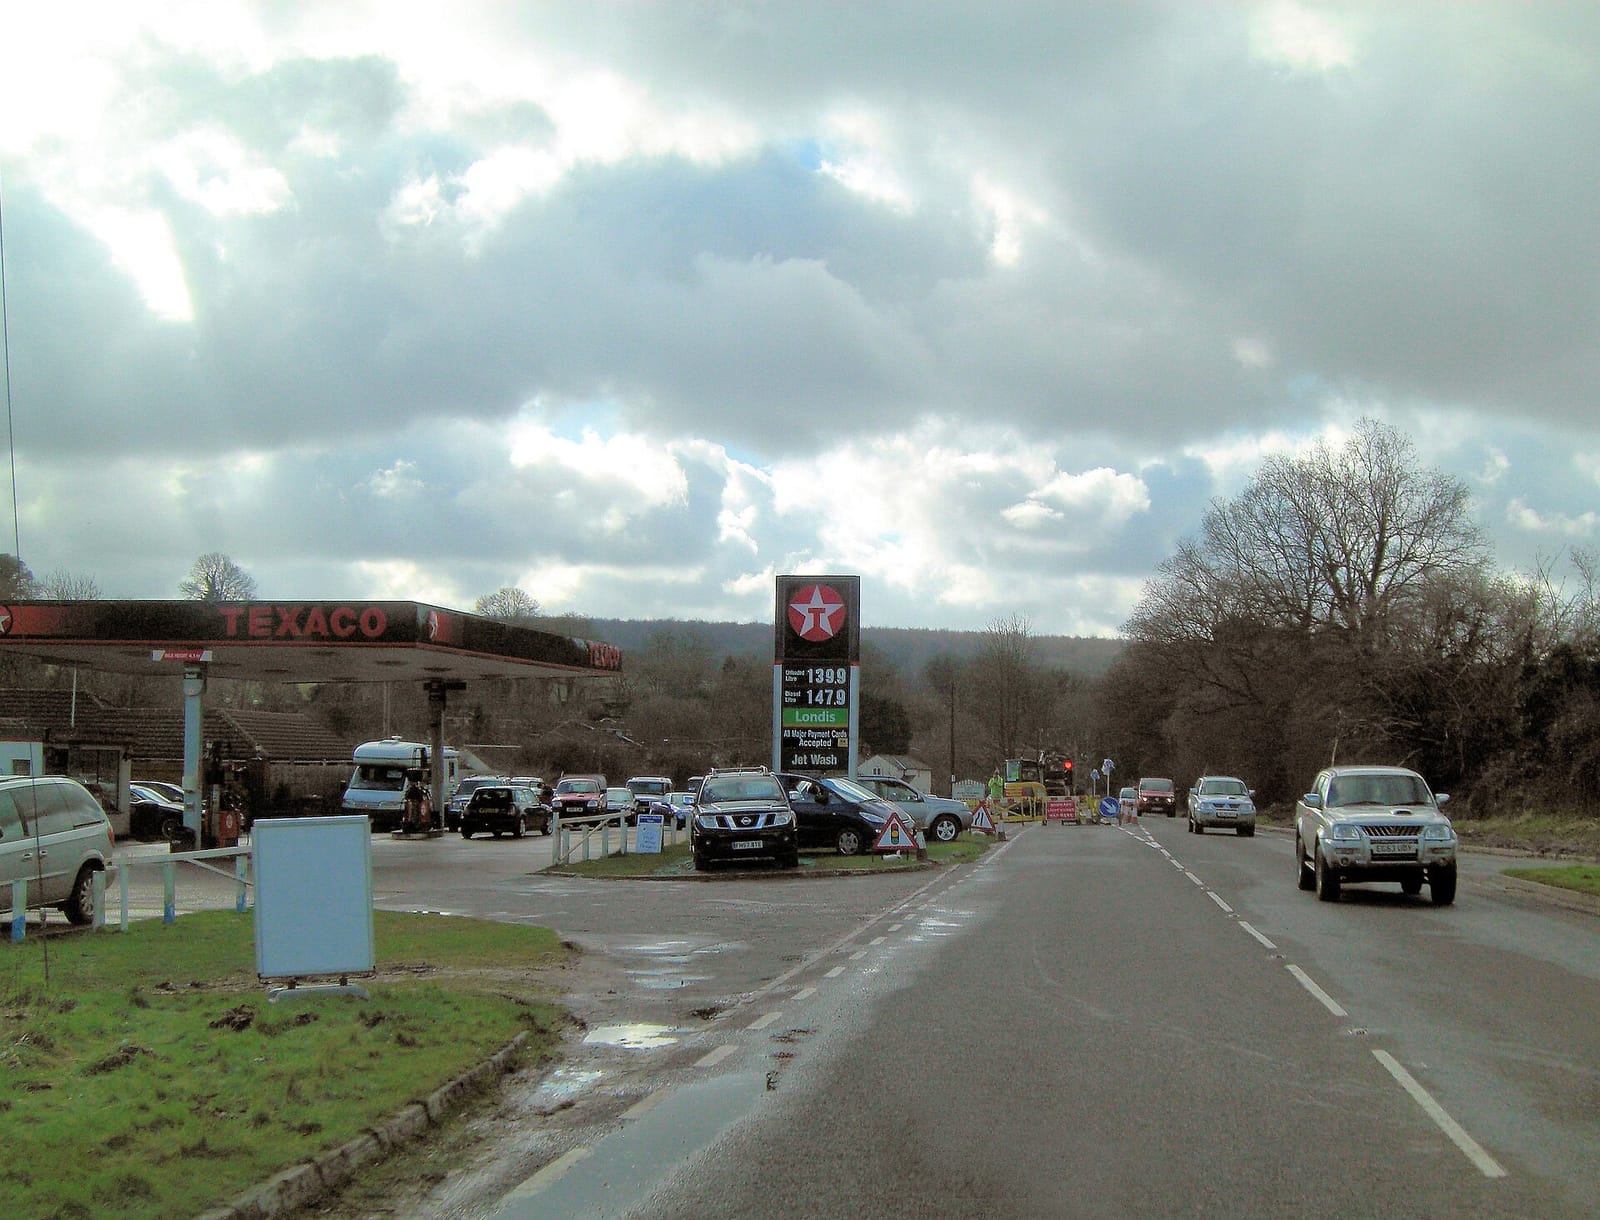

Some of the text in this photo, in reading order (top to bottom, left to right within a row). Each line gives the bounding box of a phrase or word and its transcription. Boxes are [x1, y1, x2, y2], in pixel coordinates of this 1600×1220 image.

[219, 607, 388, 637] TEXACO
[807, 667, 847, 684] 139.9
[806, 689, 846, 705] 147.9
[795, 710, 836, 722] Londis
[783, 729, 847, 739] All Major Payment Cards
[798, 738, 832, 748] Accepted
[791, 754, 838, 765] Jet Wash
